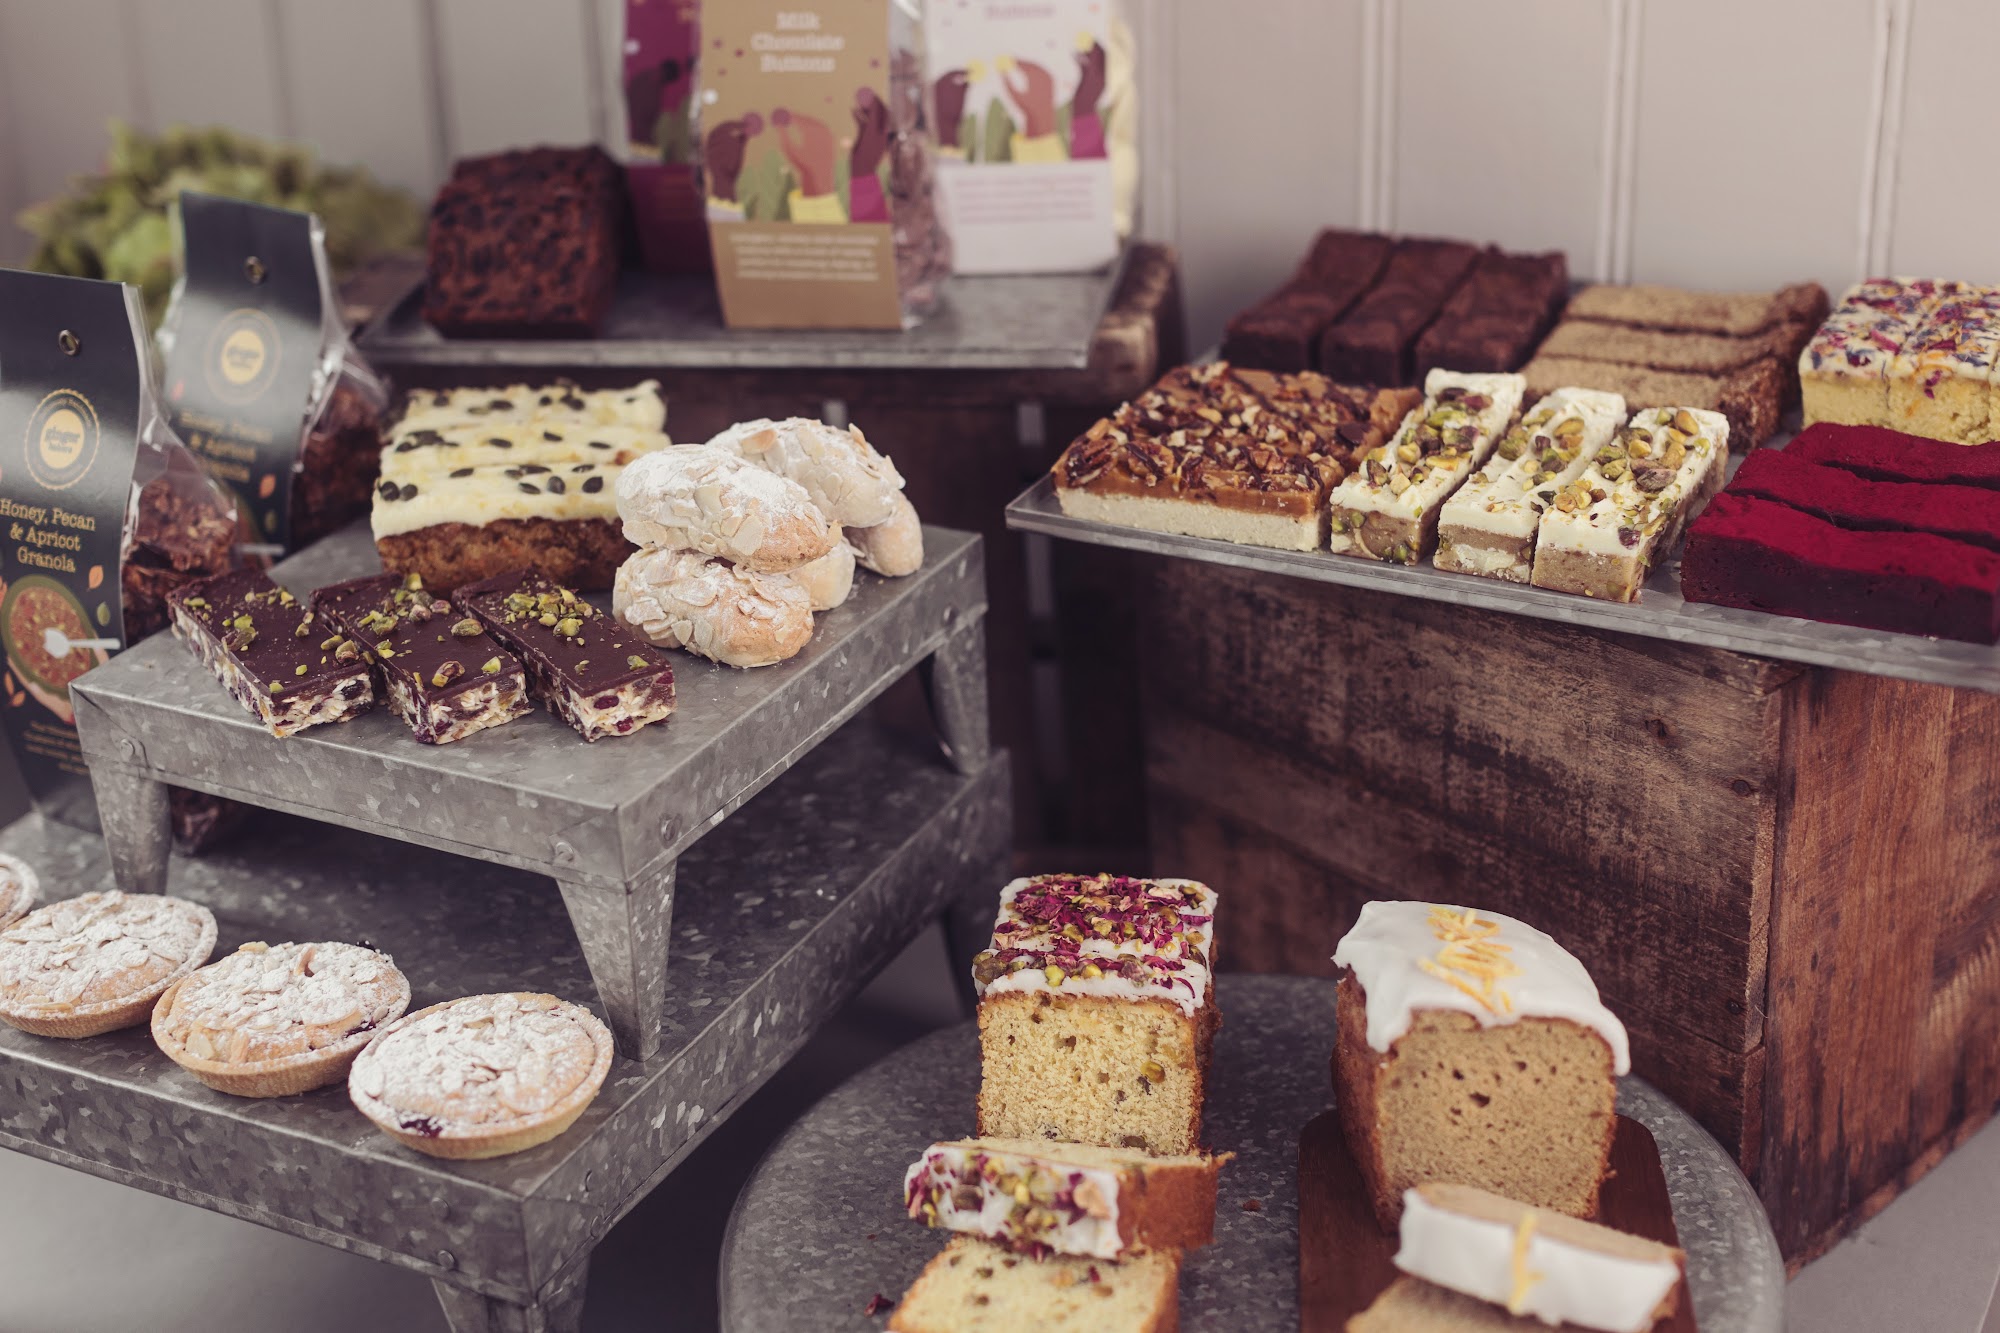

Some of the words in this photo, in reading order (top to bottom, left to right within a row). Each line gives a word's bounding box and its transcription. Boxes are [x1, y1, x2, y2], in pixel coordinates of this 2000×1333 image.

[776, 11, 820, 30] Milk
[751, 33, 844, 50] Chocolate
[761, 54, 836, 72] Buttons
[0, 498, 48, 525] Honey,
[52, 507, 96, 532] Pecan
[10, 522, 23, 540] &
[26, 526, 81, 551] Apricot
[17, 546, 76, 574] Granola
